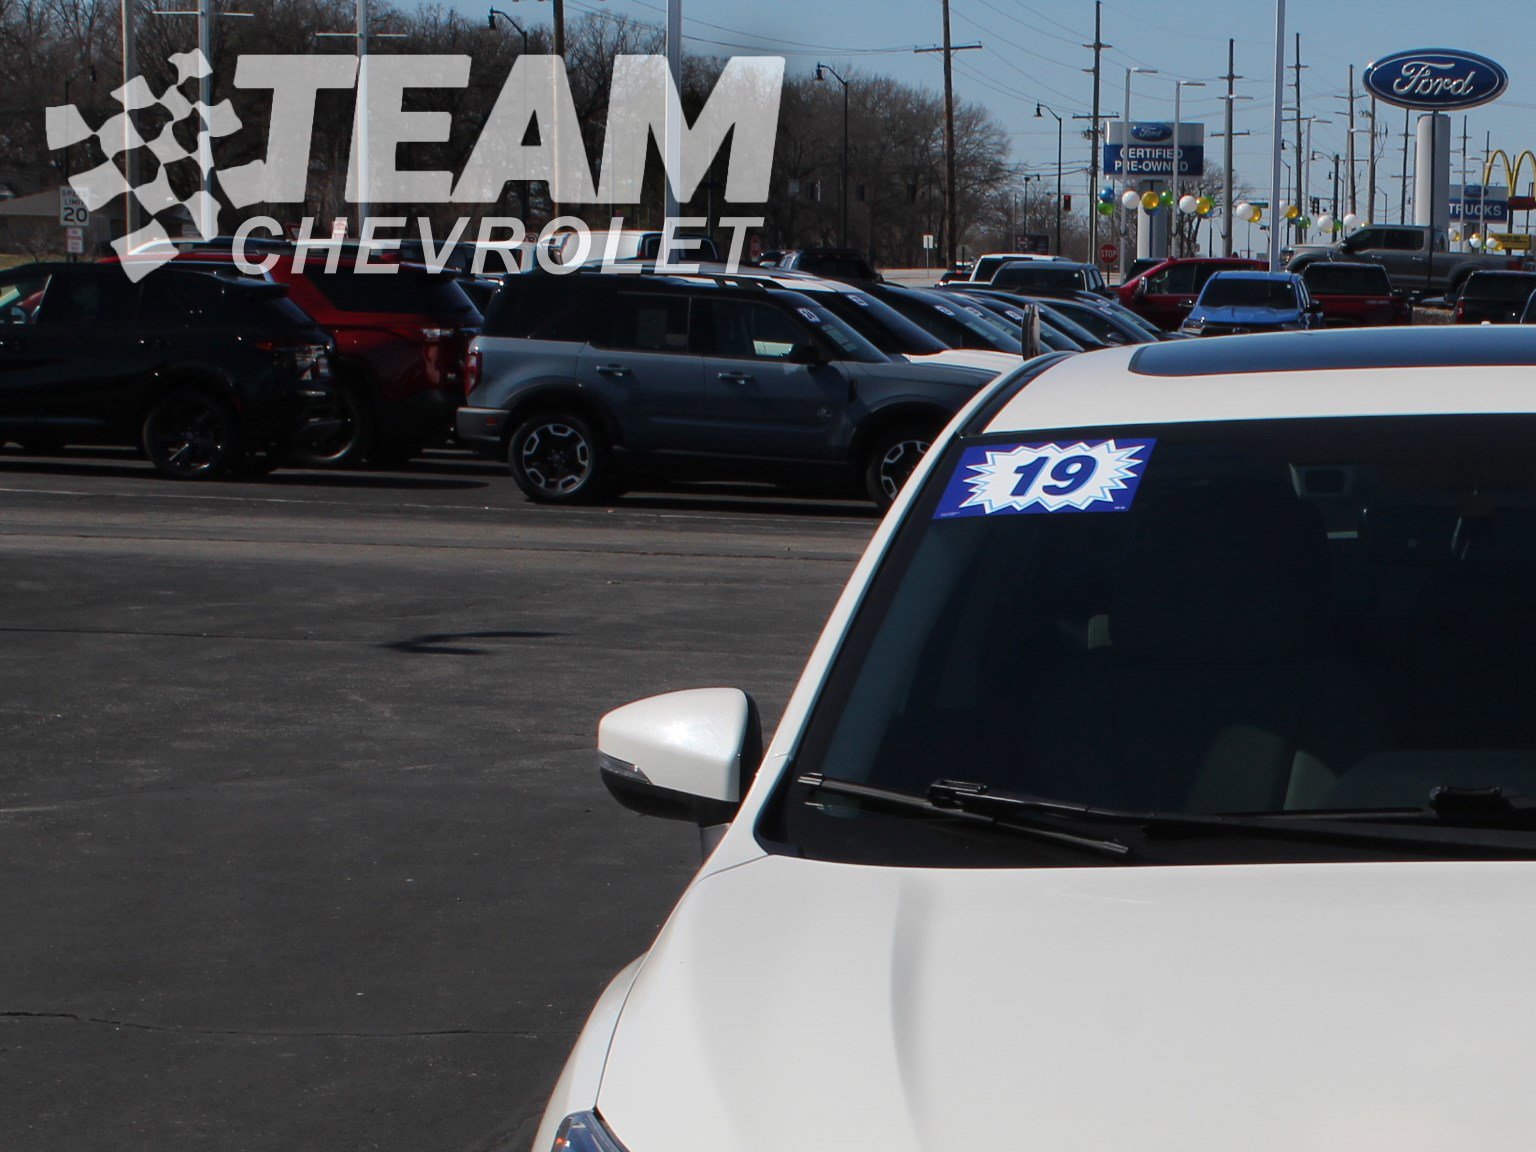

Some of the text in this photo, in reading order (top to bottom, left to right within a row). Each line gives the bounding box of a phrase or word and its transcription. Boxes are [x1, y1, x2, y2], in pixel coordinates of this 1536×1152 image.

[1393, 61, 1476, 96] Ford
[63, 207, 88, 222] 20
[1448, 203, 1502, 217] TRUCKS
[1100, 250, 1118, 258] STOP
[1010, 454, 1100, 497] 19
